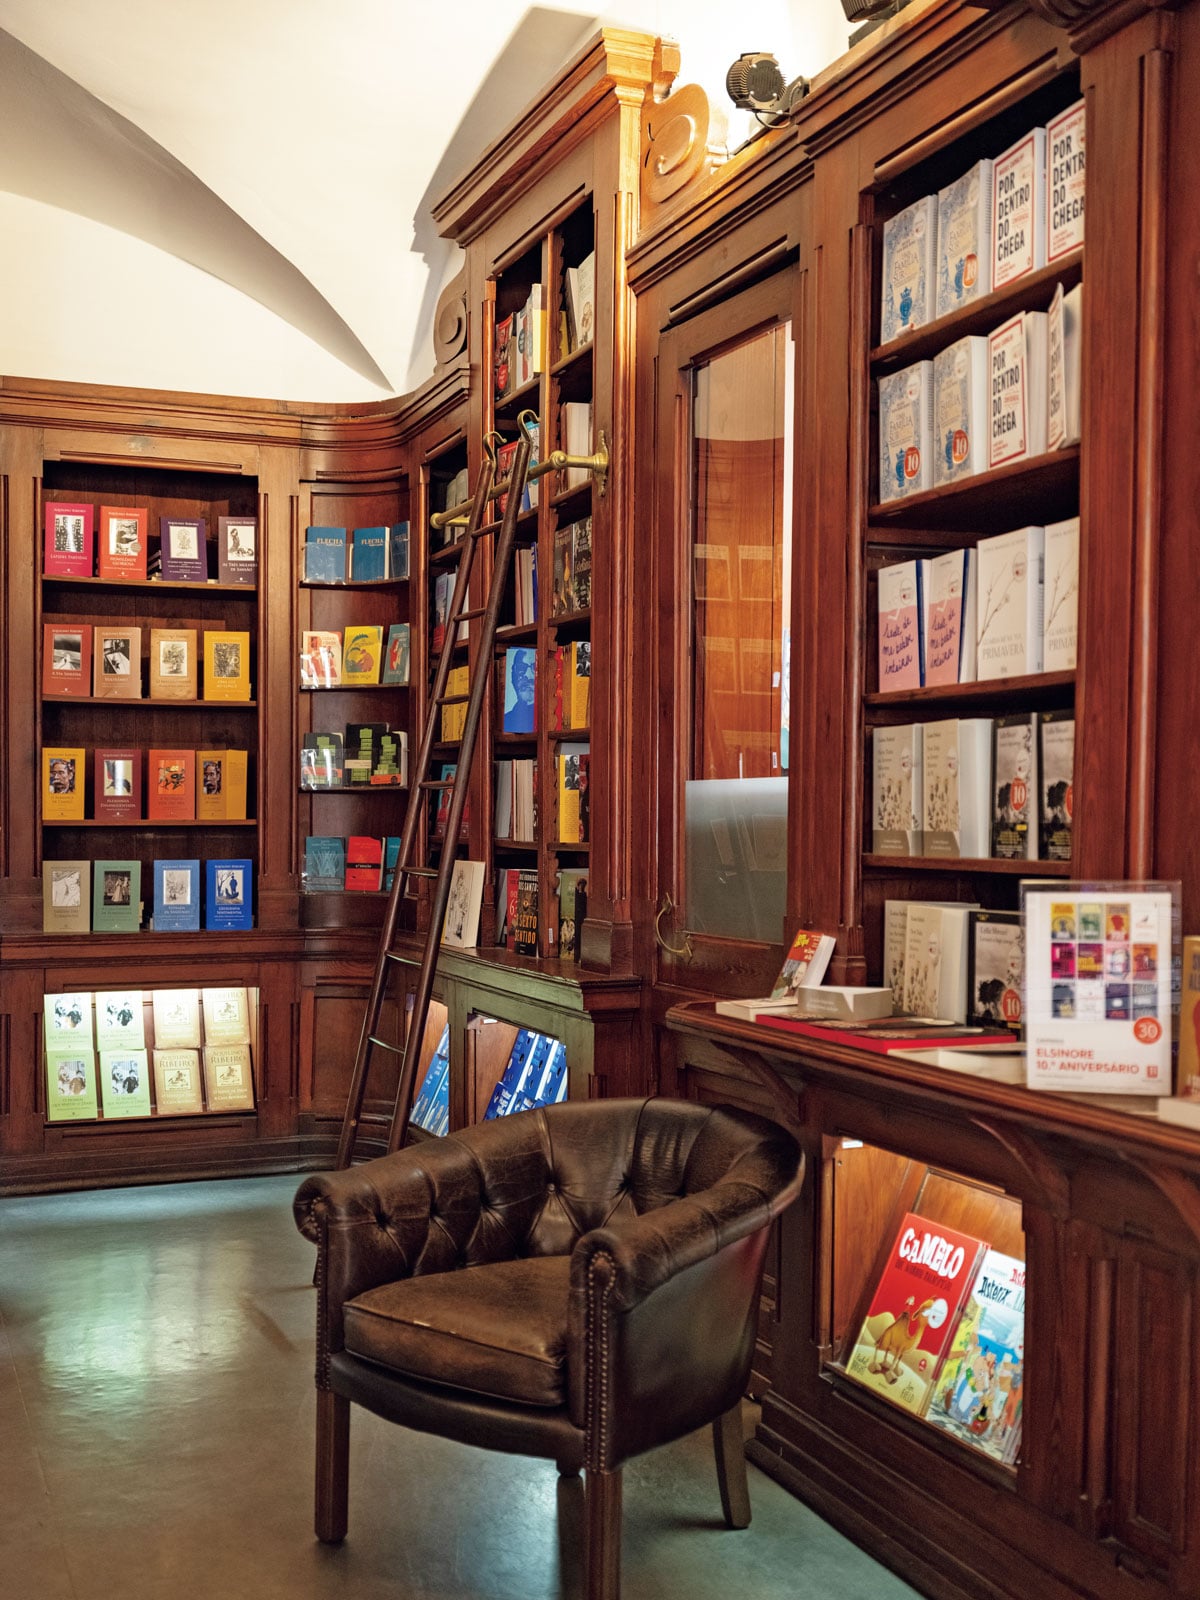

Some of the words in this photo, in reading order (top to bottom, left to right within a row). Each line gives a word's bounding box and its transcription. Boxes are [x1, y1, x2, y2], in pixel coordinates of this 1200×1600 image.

[1053, 135, 1072, 163] POR
[1053, 151, 1085, 186] DENTR
[998, 172, 1015, 198] POR
[998, 183, 1030, 219] DENTRO
[1053, 185, 1066, 208] DO
[1053, 195, 1085, 230] CHEGA
[998, 218, 1010, 241] DO
[998, 229, 1025, 261] CHEGA
[993, 350, 1006, 374] POR
[993, 365, 1020, 396] DENTRO
[993, 396, 1002, 417] DO
[993, 410, 1017, 438] CHEGA
[956, 438, 967, 456] 10
[907, 453, 919, 472] 10
[982, 643, 1025, 660] PRIMAVERA
[1048, 635, 1076, 651] PRIMA
[1014, 785, 1025, 804] 10
[519, 914, 537, 929] SEXTO
[514, 929, 536, 944] SENTIDO
[1006, 996, 1020, 1015] 10
[1139, 1024, 1158, 1039] 30
[159, 1060, 195, 1068] RIBEIRO
[211, 1055, 246, 1064] RIBEIRO
[1036, 1048, 1095, 1060] ELSINORE
[1059, 1060, 1140, 1075] ANIVERSÁRIO
[899, 1227, 965, 1280] CAMELO
